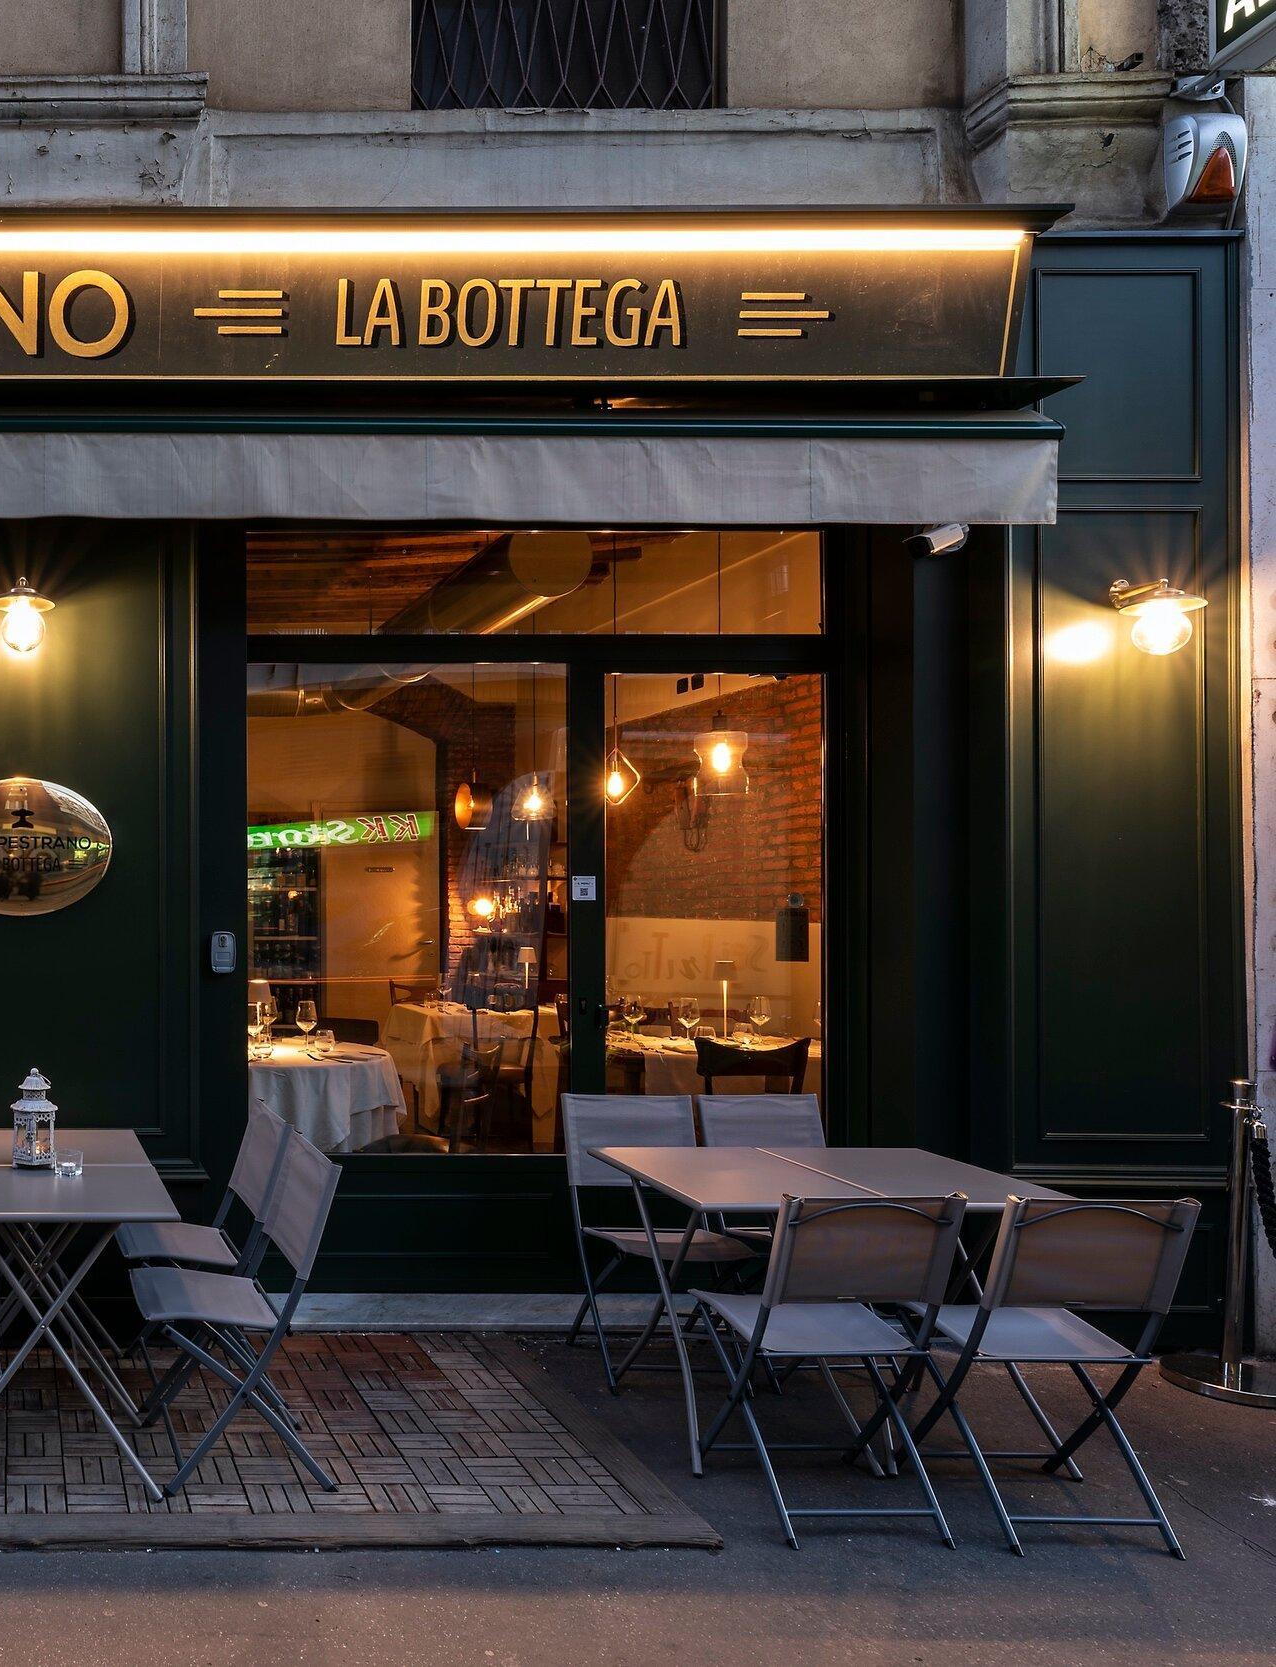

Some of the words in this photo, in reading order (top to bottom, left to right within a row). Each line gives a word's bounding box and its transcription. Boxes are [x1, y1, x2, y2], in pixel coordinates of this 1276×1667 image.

[335, 277, 400, 346] LA
[418, 277, 682, 347] BOTTEGA
[3, 857, 62, 873] BOTTEGA
